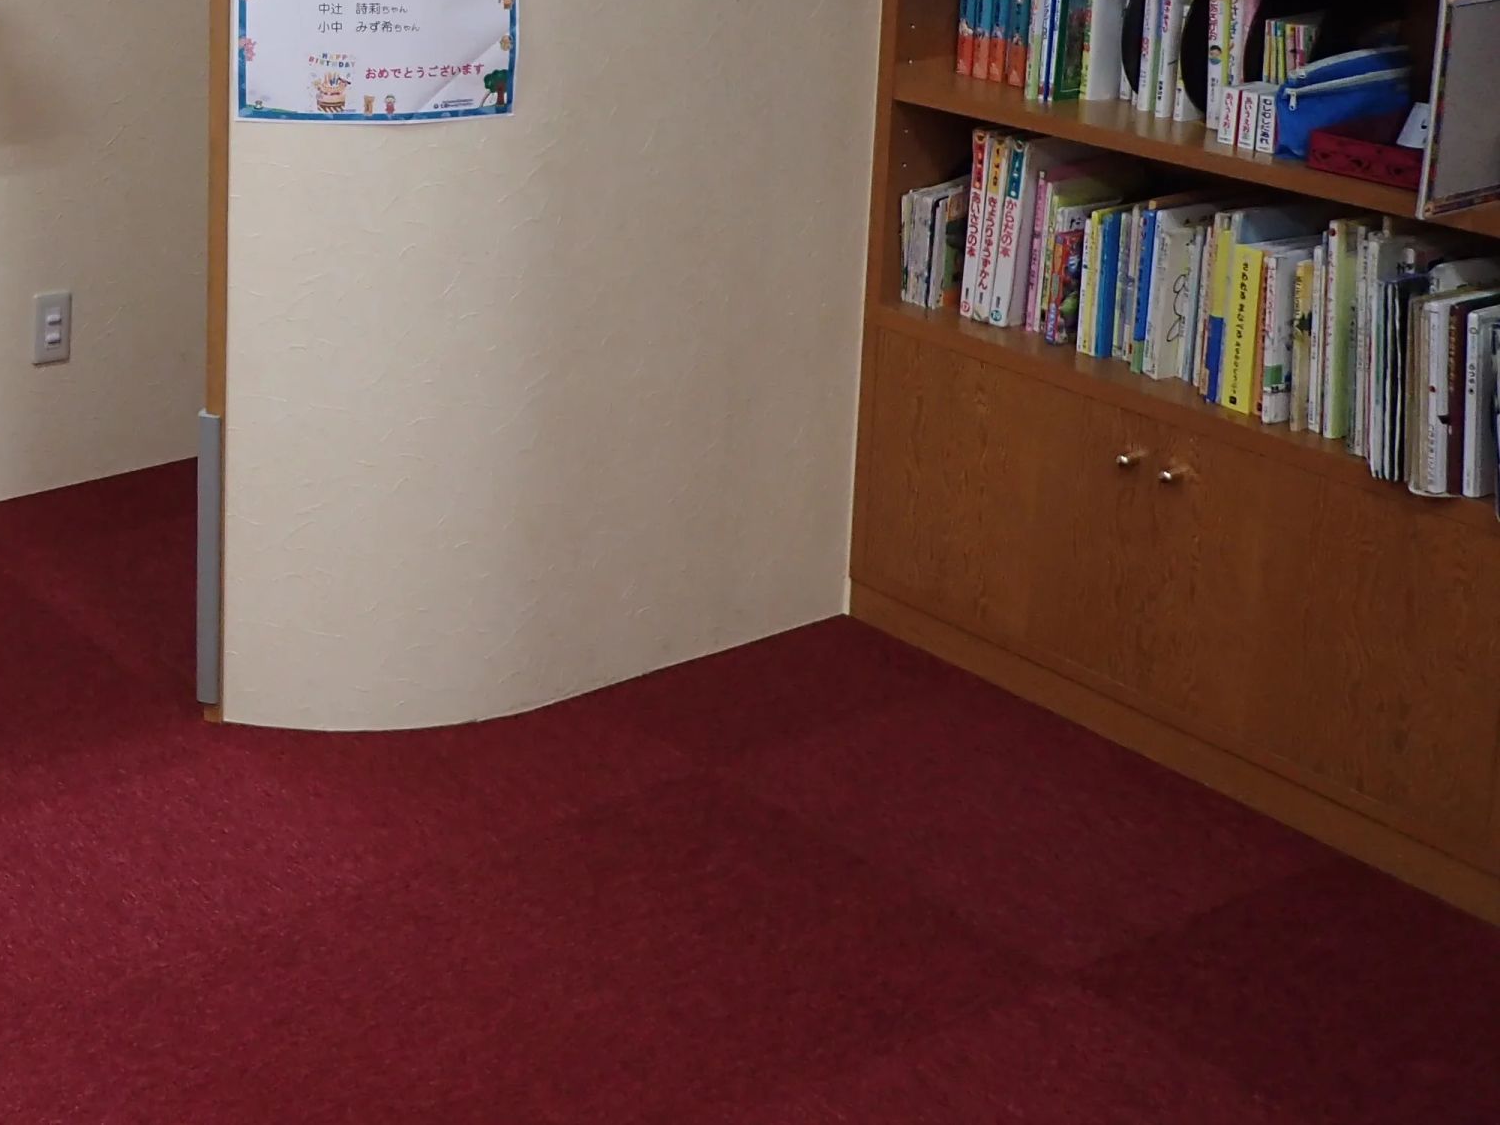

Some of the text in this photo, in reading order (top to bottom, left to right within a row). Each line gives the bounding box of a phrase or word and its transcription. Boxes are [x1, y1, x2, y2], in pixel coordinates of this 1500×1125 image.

[318, 2, 408, 15] 中辻 詩莉ちゃん
[318, 20, 420, 33] 小中 みず希ちゃん
[365, 63, 485, 79] おめでとうございます
[966, 191, 982, 259] あいさつの本
[999, 199, 1018, 259] からだの本
